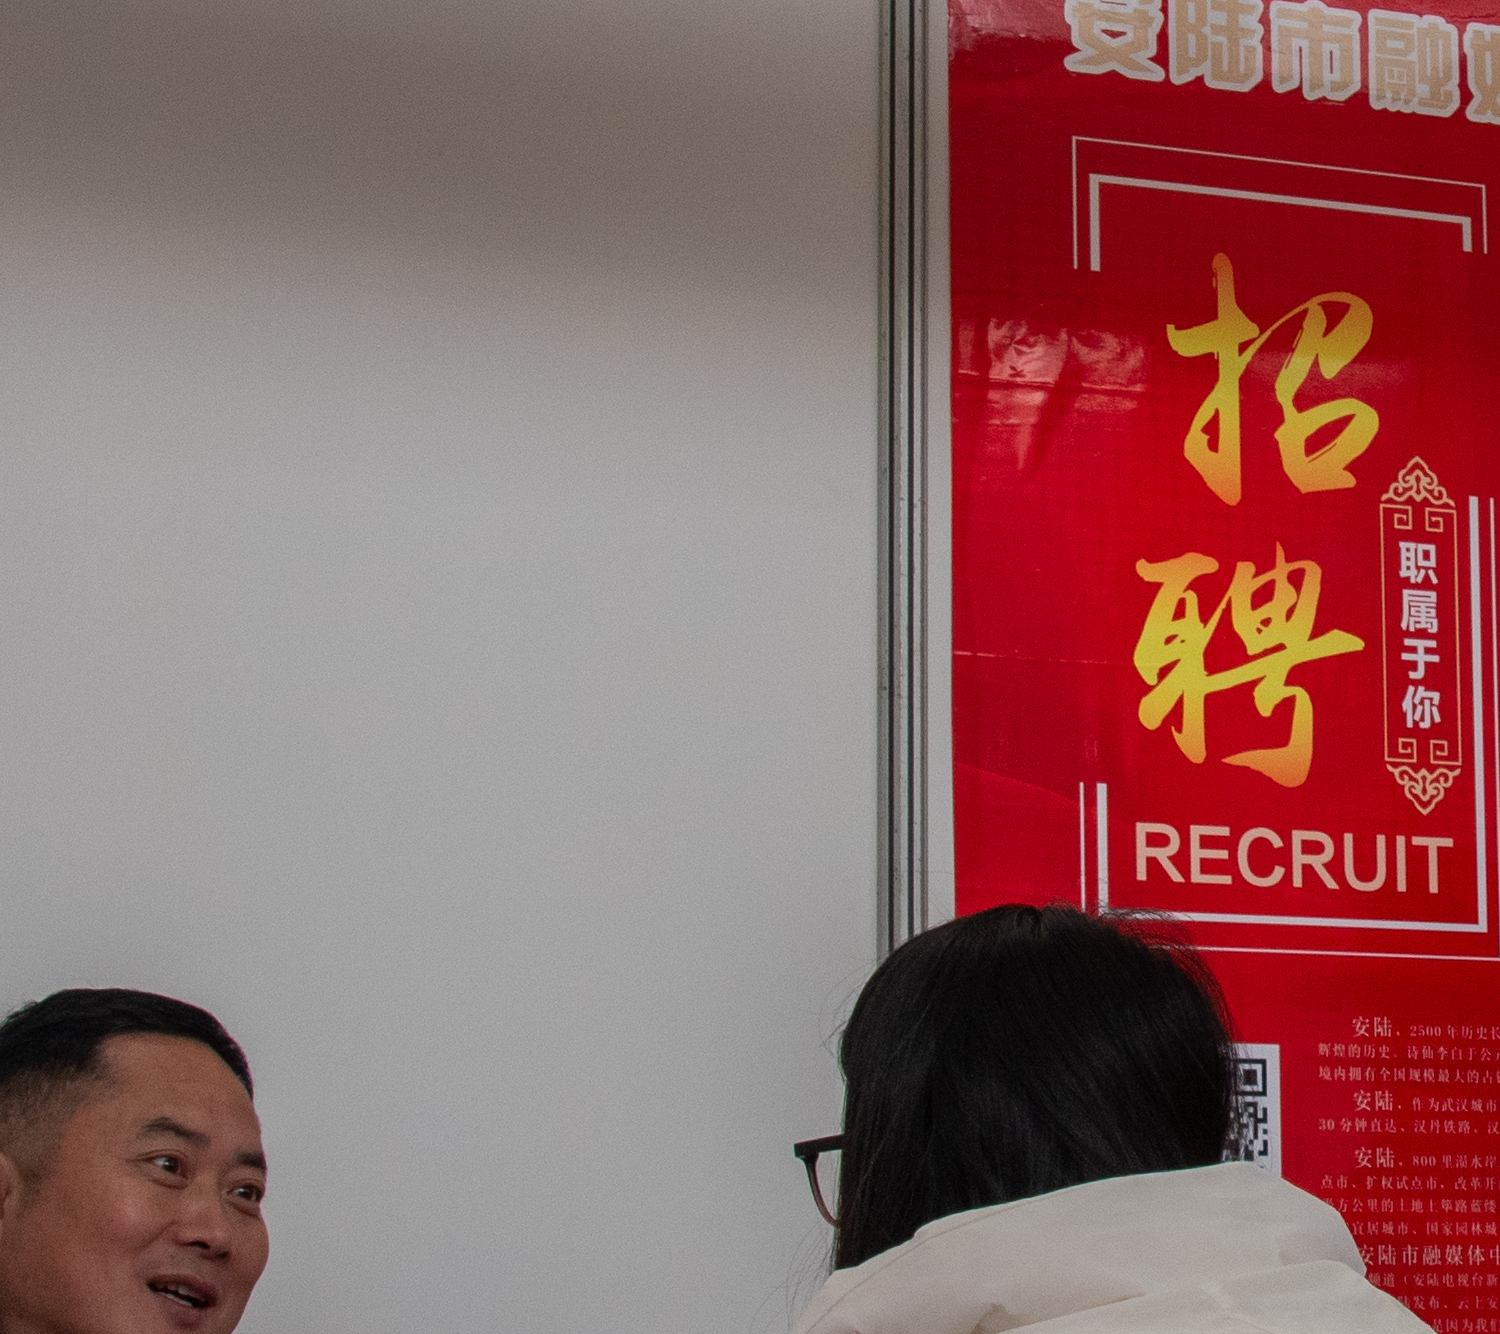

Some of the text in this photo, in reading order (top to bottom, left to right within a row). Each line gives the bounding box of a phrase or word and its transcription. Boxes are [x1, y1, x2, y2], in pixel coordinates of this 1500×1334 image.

[1133, 253, 1380, 787] 招聘
[1398, 540, 1442, 730] 职属于你
[1135, 822, 1454, 894] RECRUIT
